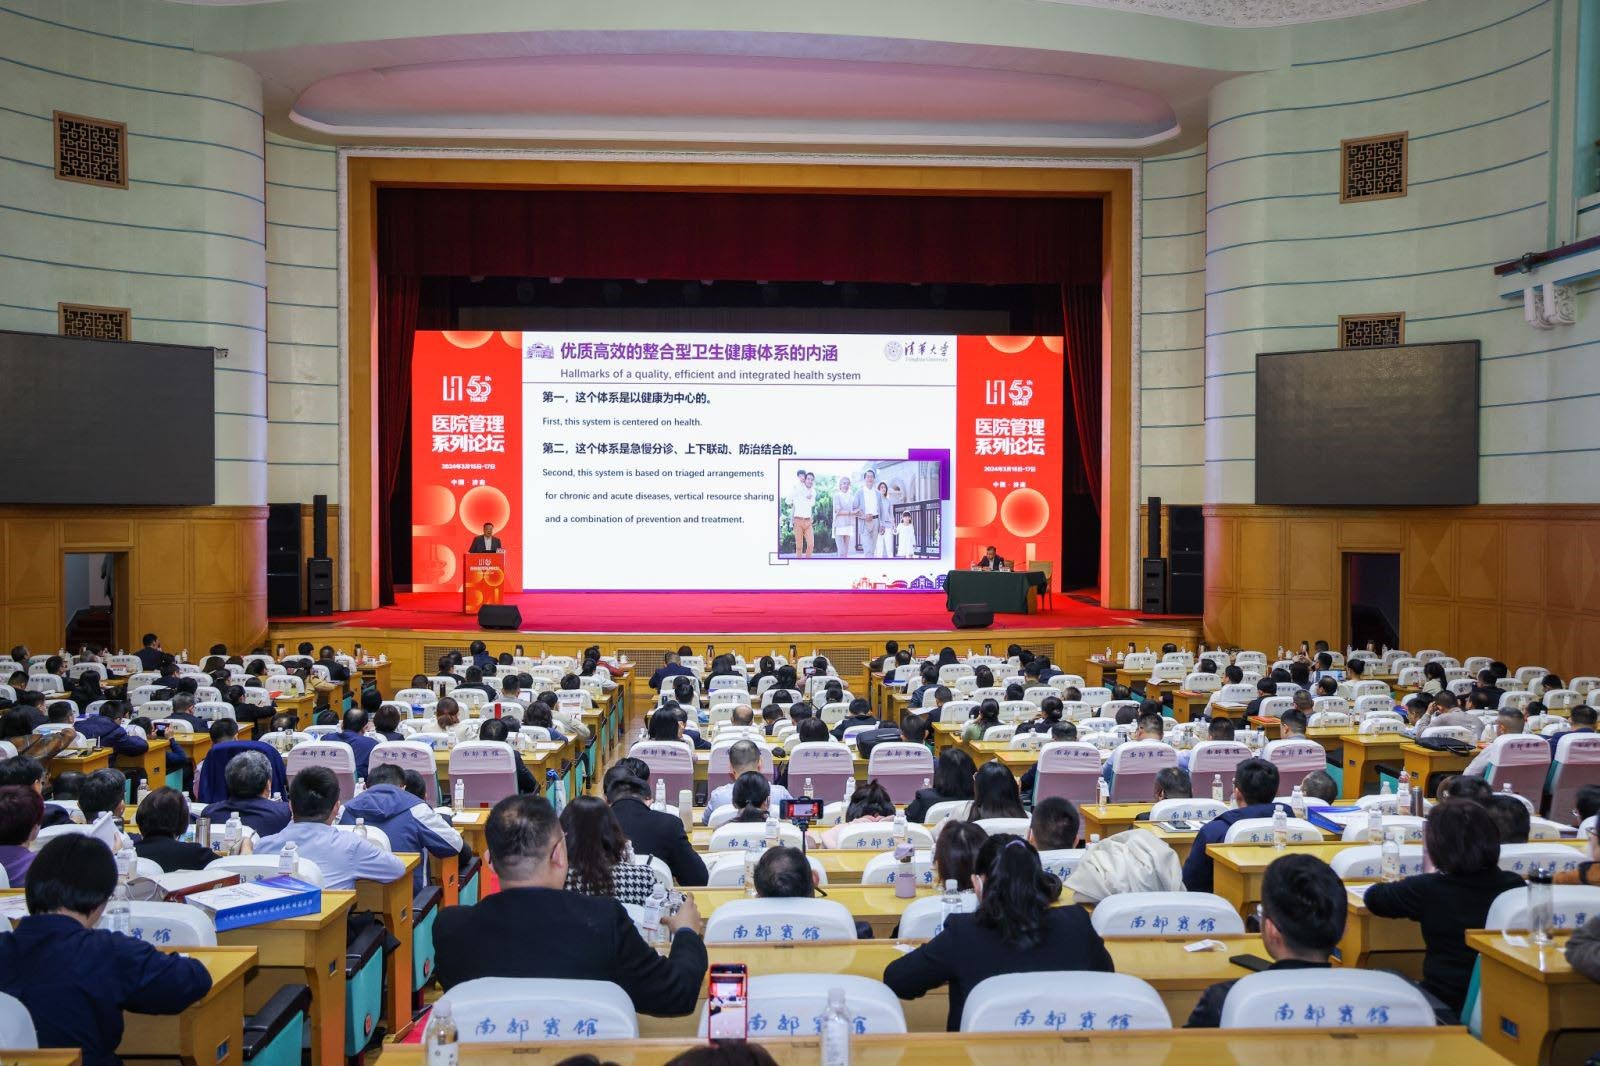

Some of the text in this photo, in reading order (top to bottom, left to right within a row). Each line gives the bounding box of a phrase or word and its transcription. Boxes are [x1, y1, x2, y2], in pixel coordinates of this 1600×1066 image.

[560, 342, 838, 362] 优质高效的整合型卫生健康体系的内涵
[560, 368, 861, 384] Hallmarks of a quality, efficient and integrated health system
[431, 414, 505, 433] 医院管理
[542, 416, 703, 428] First, this system is centered on health.
[975, 418, 1045, 436] 医院管理
[431, 433, 505, 453] 系列论坛
[974, 437, 1046, 456] 系列论坛
[542, 467, 765, 480] Second, this system is based on triaged arrangements
[544, 490, 775, 503] for chronic and acute diseases, vertical resource sharing
[544, 513, 561, 524] and
[570, 513, 623, 524] combination
[624, 513, 634, 523] of
[636, 514, 682, 526] prevention
[683, 514, 699, 524] and
[701, 515, 746, 524] treatment.
